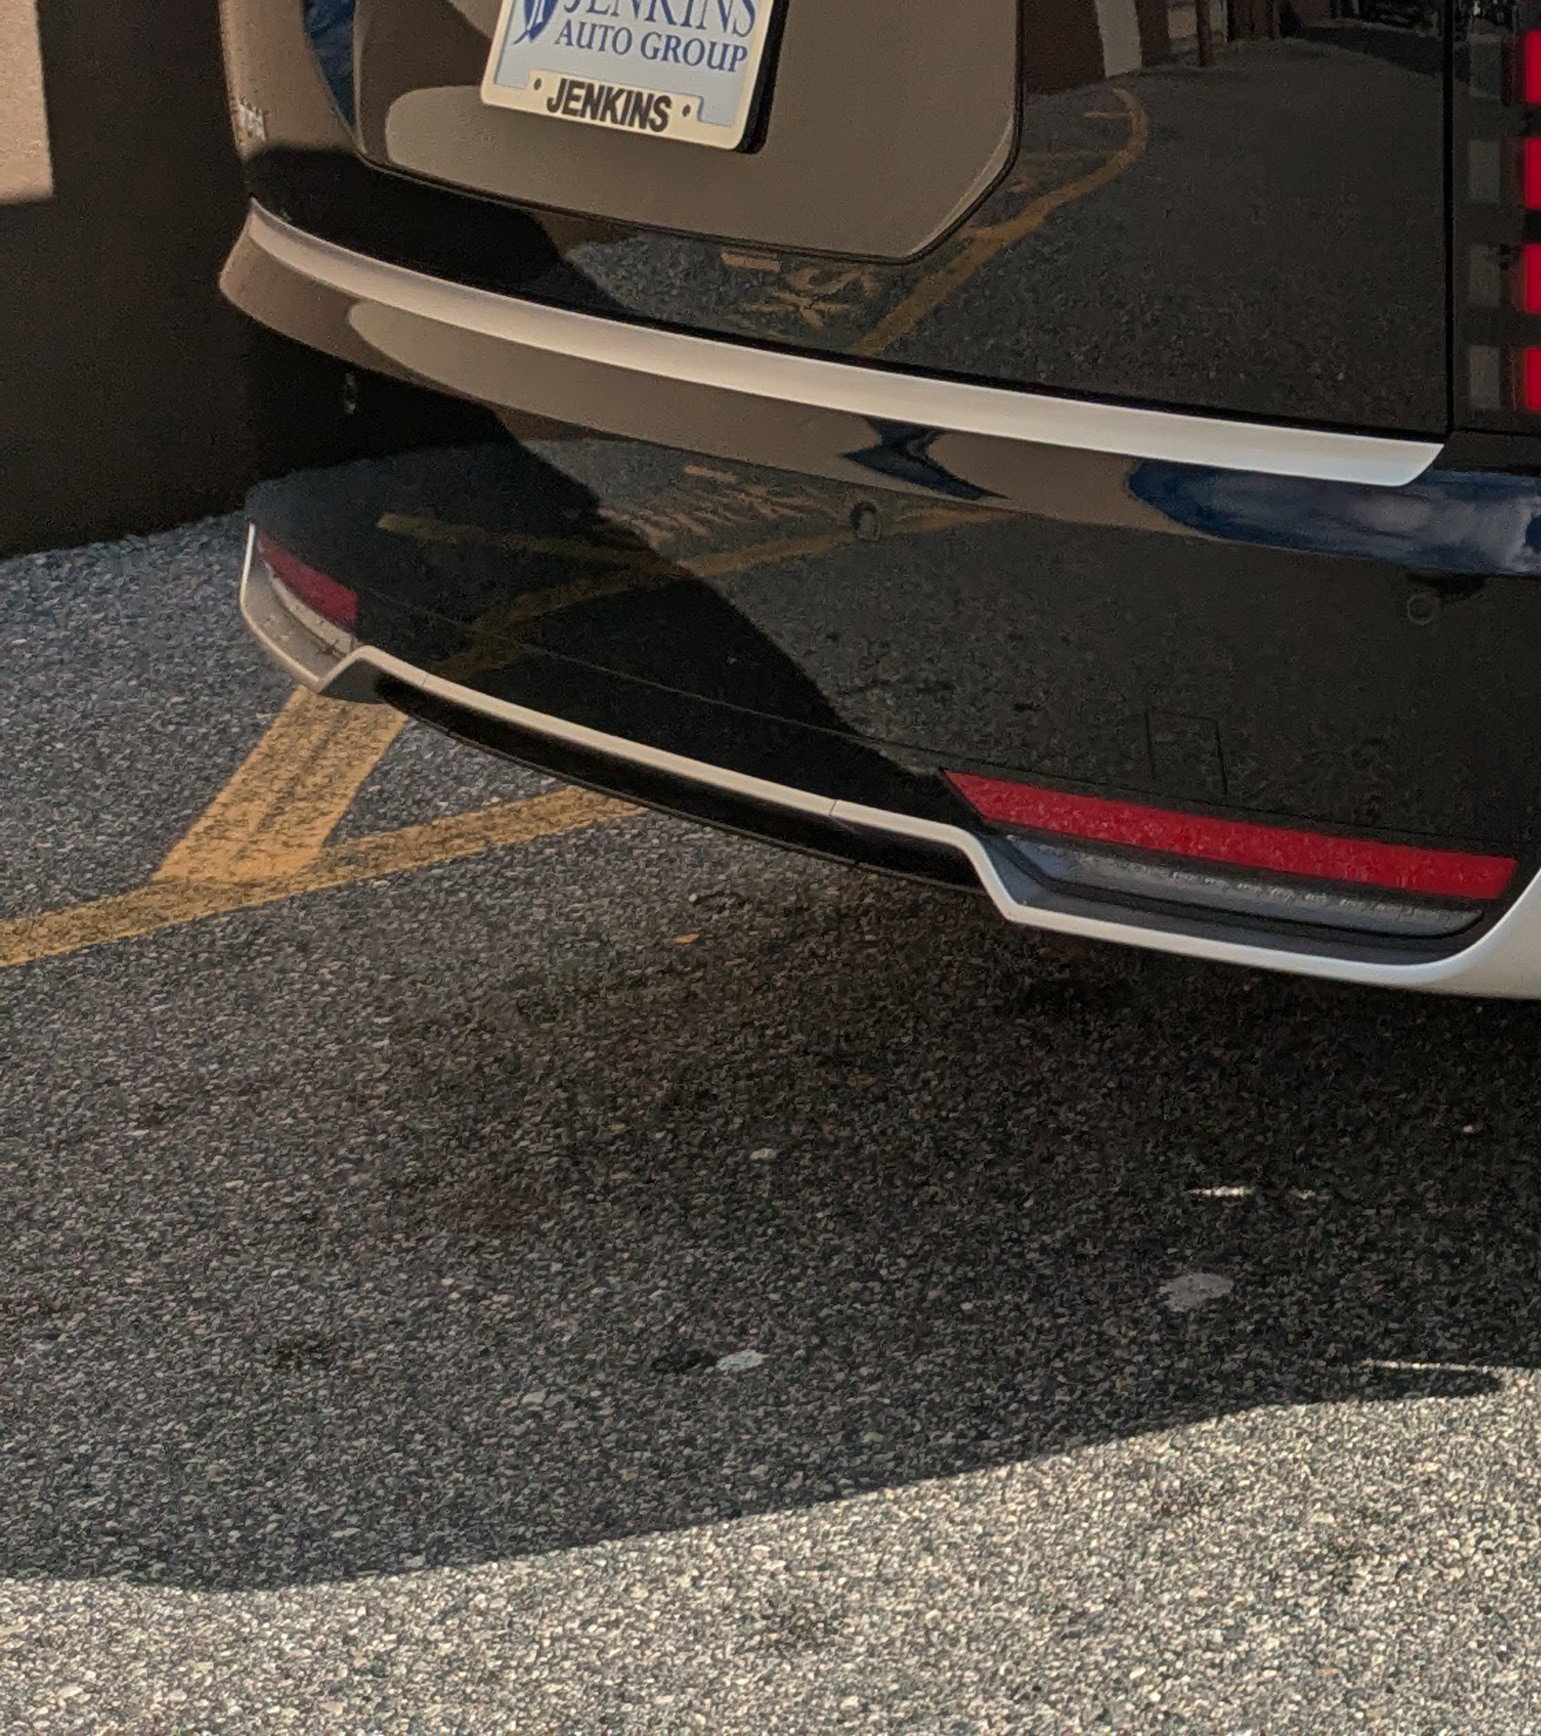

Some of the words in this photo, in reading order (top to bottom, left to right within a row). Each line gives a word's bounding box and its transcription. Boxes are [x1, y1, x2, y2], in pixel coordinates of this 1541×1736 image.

[554, 18, 633, 56] AUTO
[639, 30, 749, 74] GROUP
[545, 76, 673, 133] JENKINS
